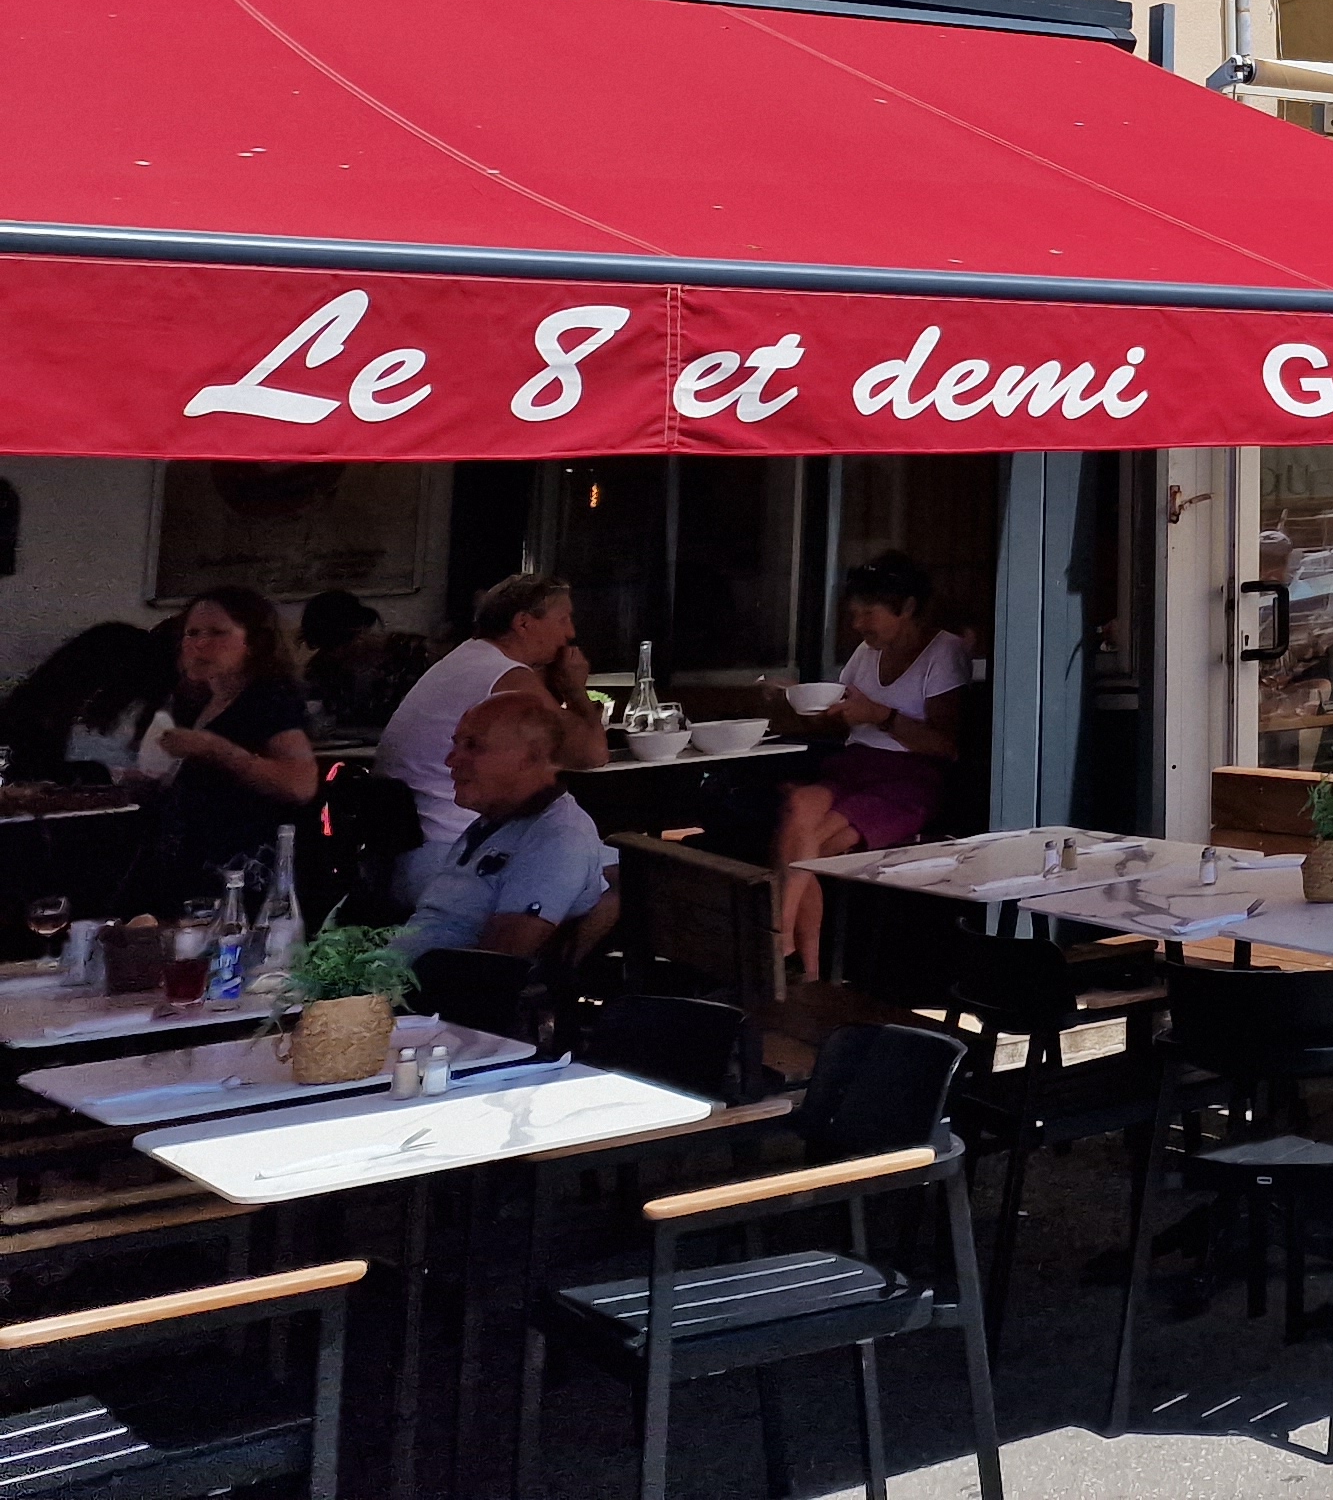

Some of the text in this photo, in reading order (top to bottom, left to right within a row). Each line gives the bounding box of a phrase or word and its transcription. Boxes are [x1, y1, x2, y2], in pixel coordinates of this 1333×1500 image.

[183, 288, 432, 424] Le
[509, 305, 631, 422] 8
[672, 332, 805, 424] et
[852, 325, 1149, 421] demi
